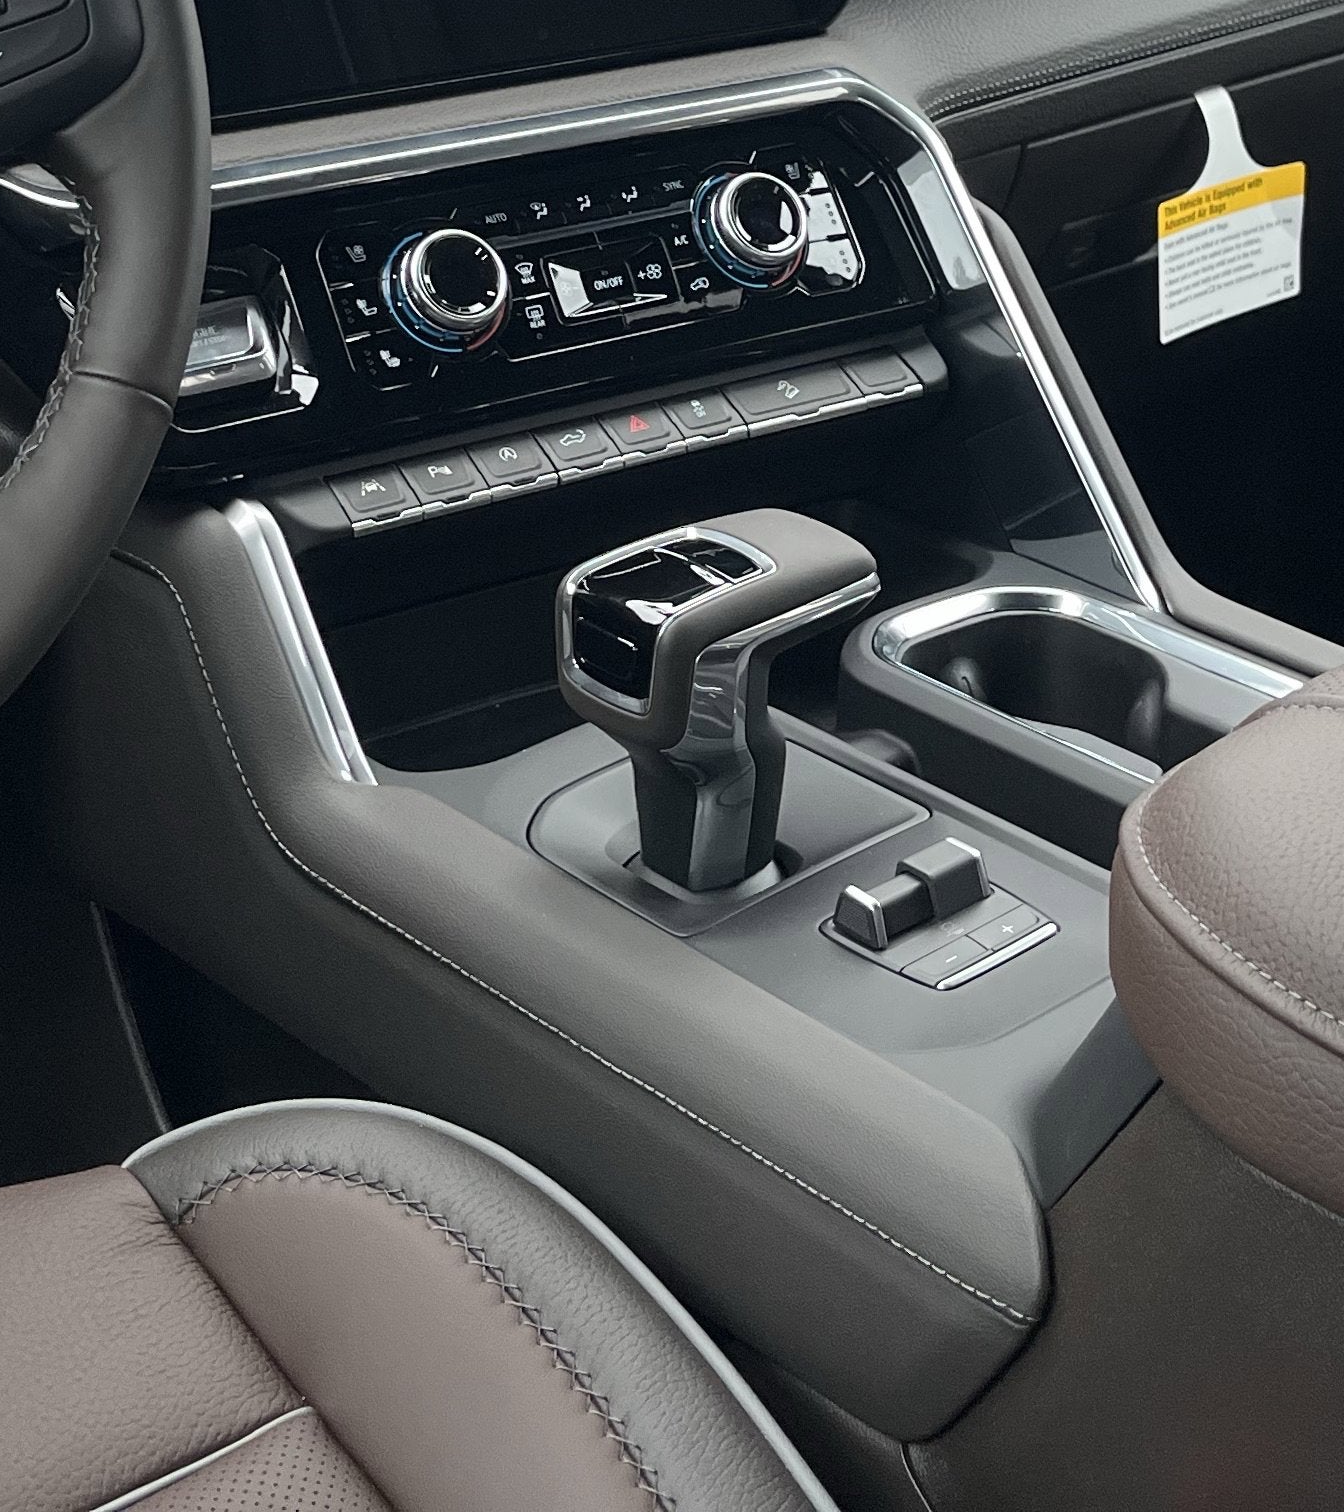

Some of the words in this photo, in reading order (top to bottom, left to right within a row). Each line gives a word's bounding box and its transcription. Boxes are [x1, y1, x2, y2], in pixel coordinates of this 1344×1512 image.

[662, 180, 685, 192] SYNC
[1179, 196, 1202, 213] Vehicle
[1213, 182, 1245, 201] Equipped
[1247, 178, 1263, 190] with
[485, 213, 507, 224] AUTO
[1164, 212, 1195, 230] Advanced
[1198, 208, 1206, 219] Air
[1209, 203, 1226, 217] Bags
[674, 235, 689, 246] A/C
[594, 277, 624, 290] ON/OFF
